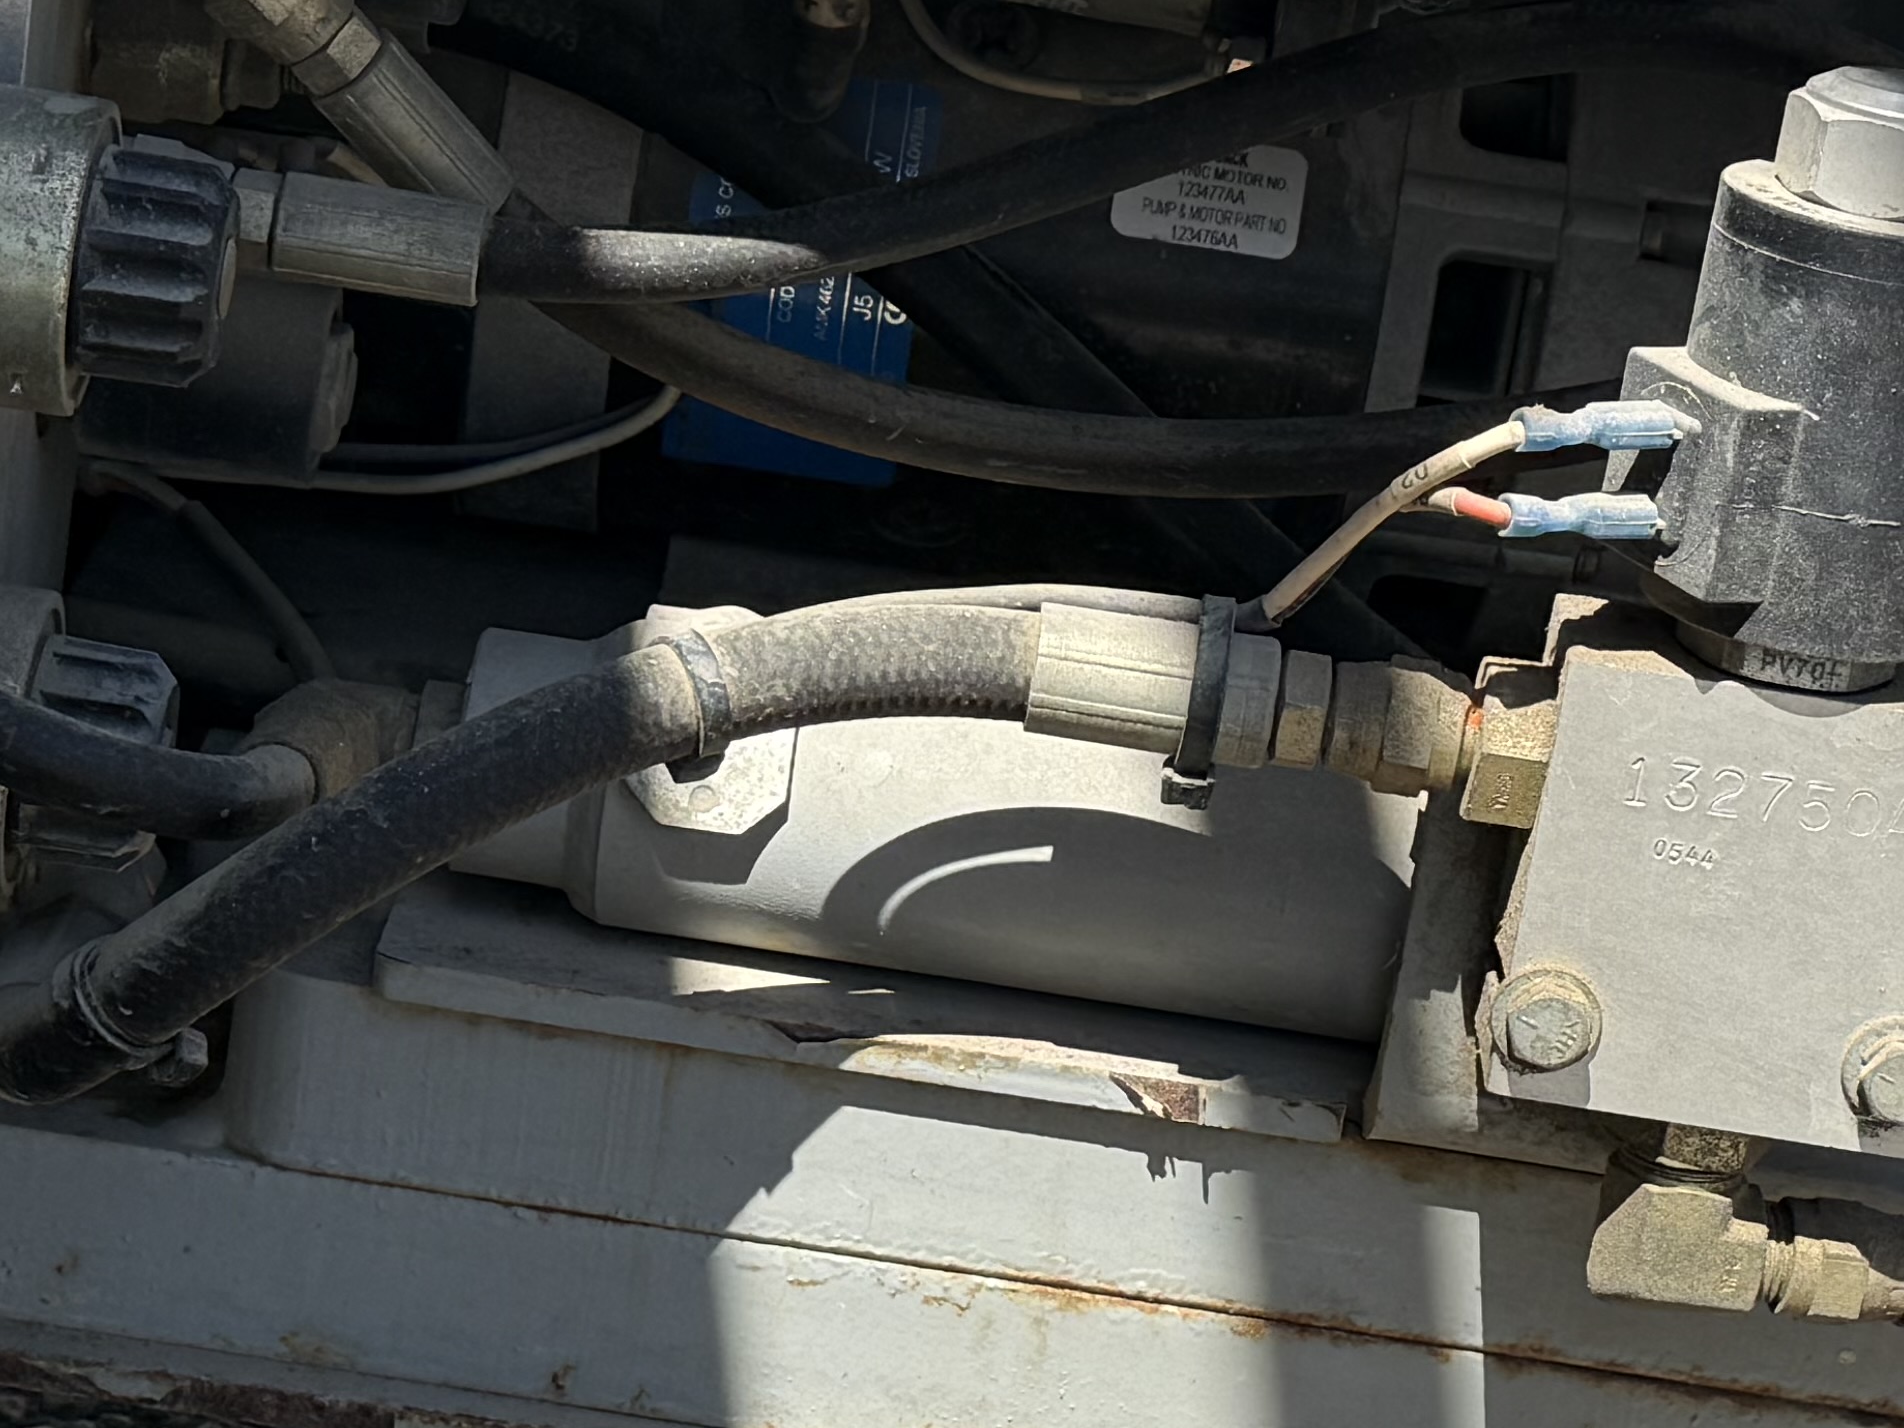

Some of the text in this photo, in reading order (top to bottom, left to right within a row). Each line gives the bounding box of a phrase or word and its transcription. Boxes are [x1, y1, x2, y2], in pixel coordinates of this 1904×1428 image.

[1214, 166, 1263, 186] MOTOR
[1141, 196, 1178, 215] PUMP
[1188, 204, 1233, 227] MOTOR
[1234, 210, 1266, 233] PART
[1652, 838, 1718, 870] 0544
